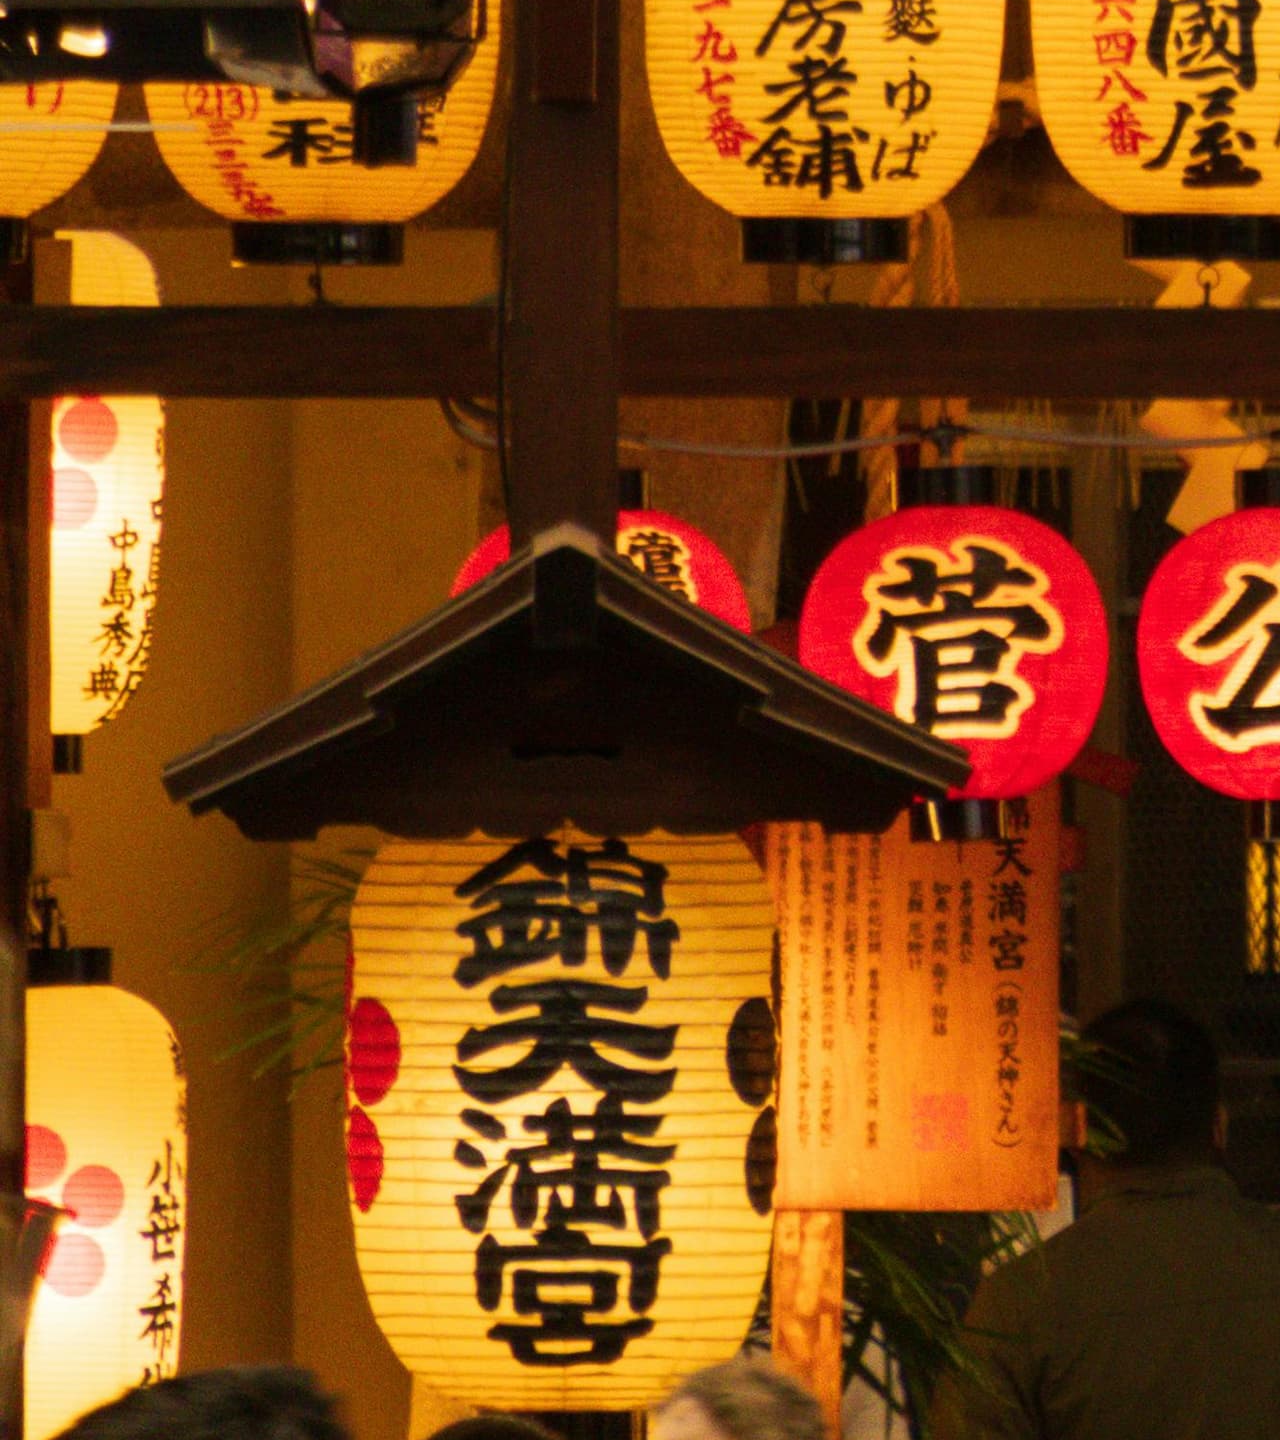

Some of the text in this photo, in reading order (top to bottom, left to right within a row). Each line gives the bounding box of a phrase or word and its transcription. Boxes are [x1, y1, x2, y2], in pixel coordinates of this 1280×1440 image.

[864, 542, 1054, 736] 菅
[453, 837, 679, 1367] 錦天満宮
